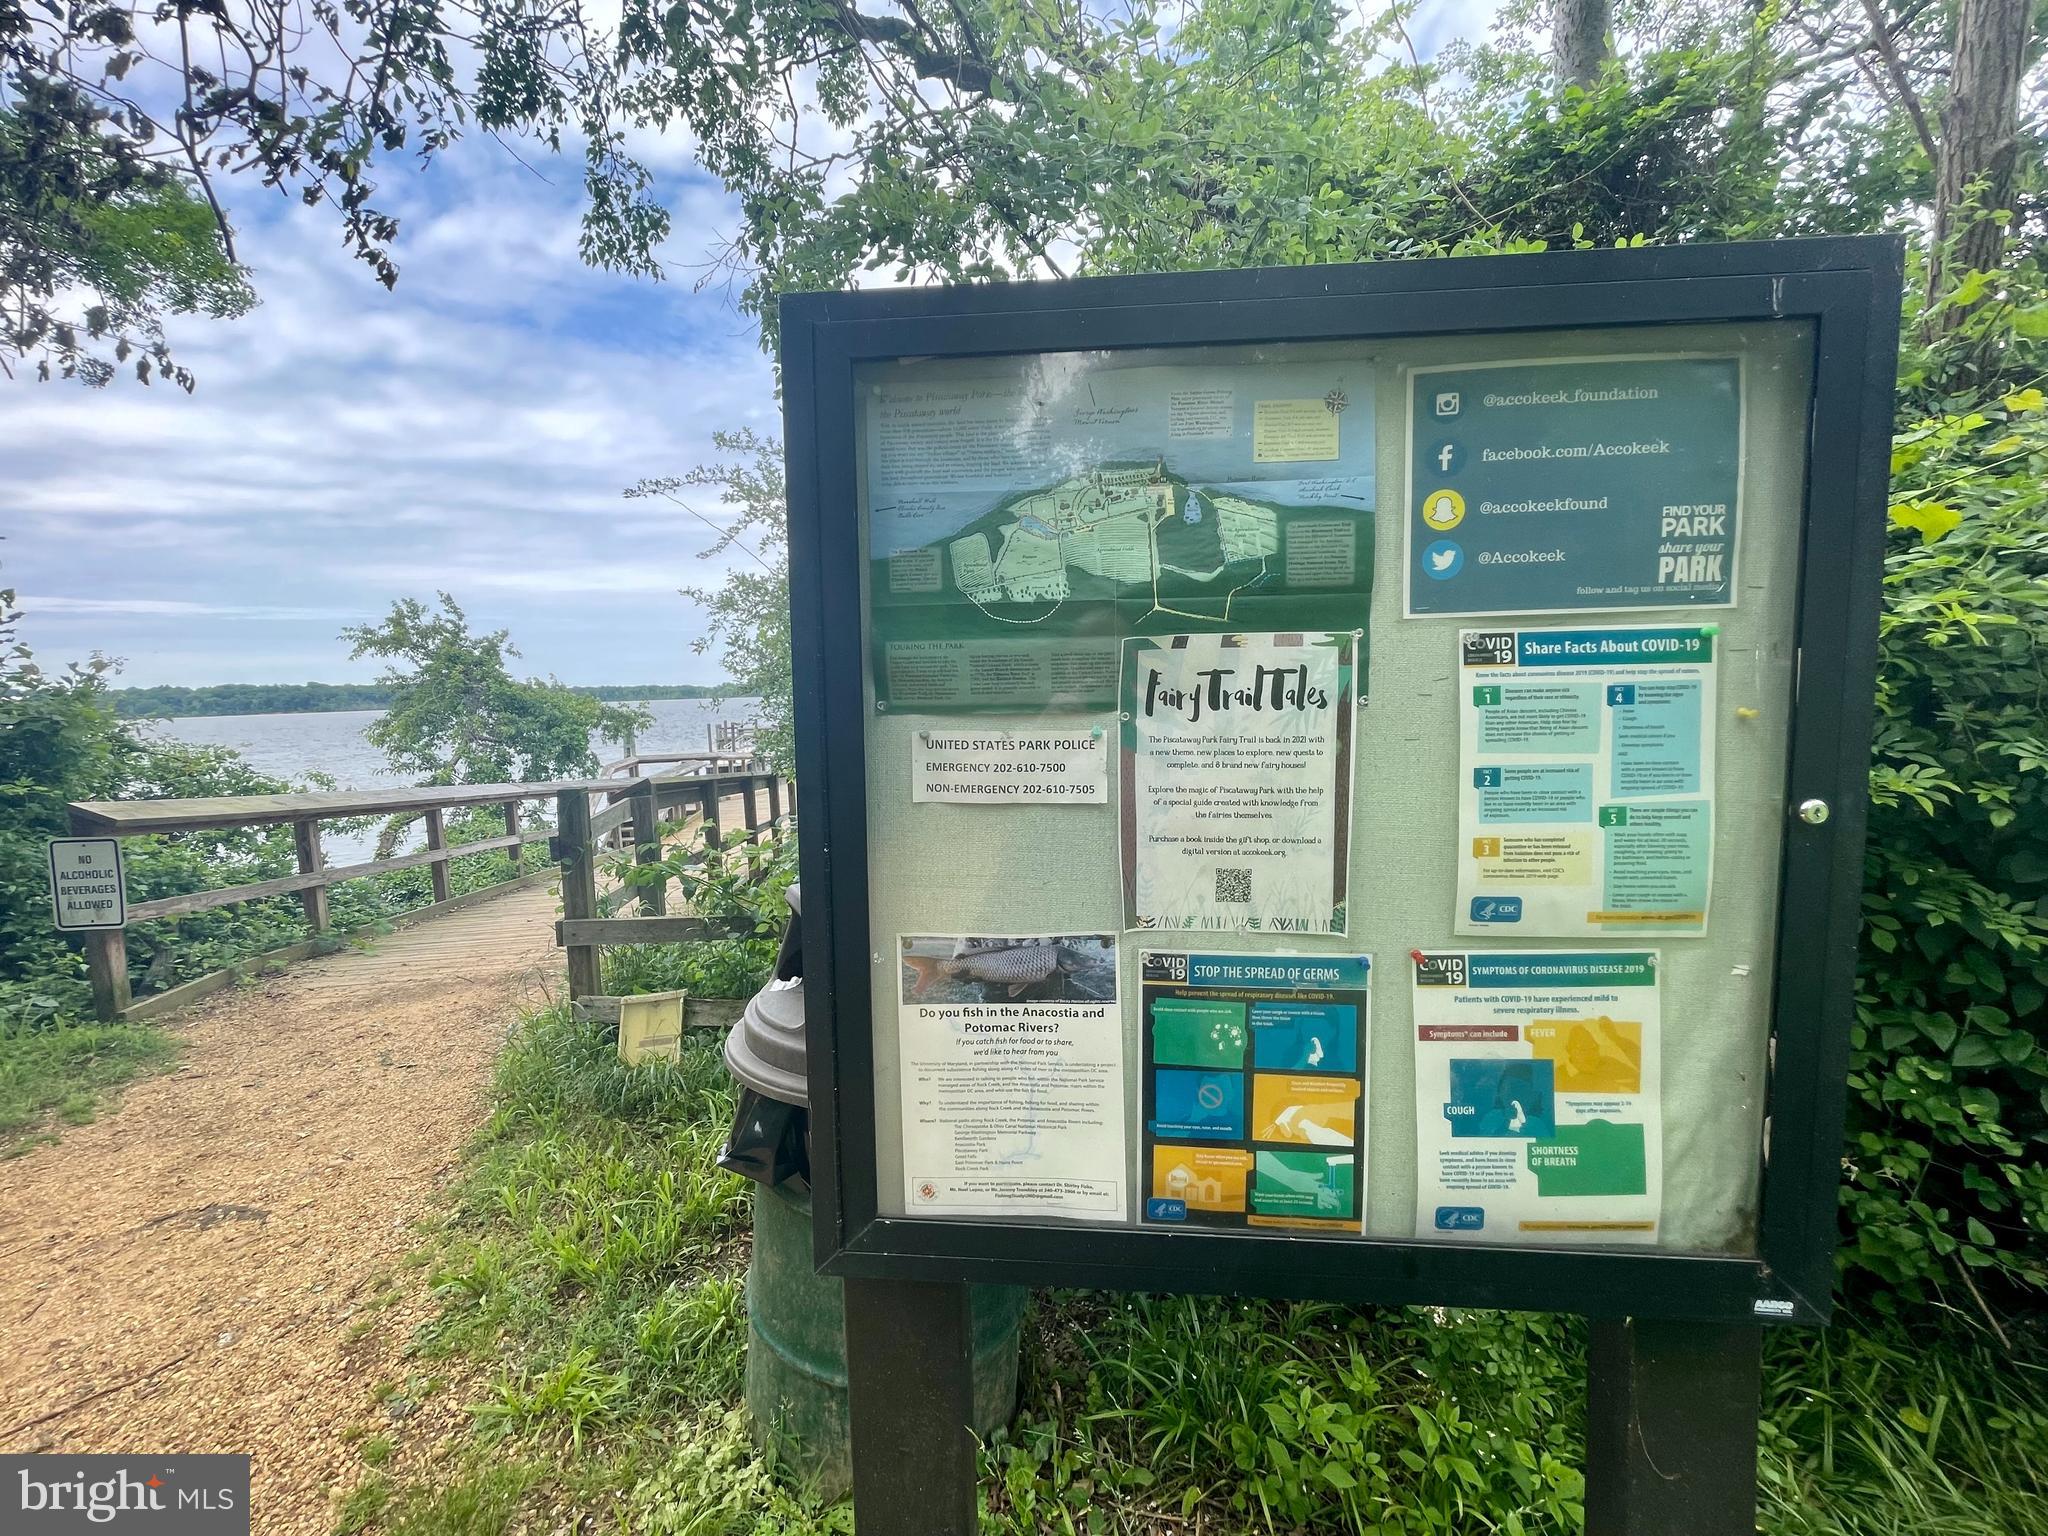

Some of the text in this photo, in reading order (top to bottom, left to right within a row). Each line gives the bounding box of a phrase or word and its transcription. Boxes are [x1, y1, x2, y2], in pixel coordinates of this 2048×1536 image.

[1483, 387, 1658, 406] @accokeek_foundation
[1482, 441, 1670, 462] facebook.com/Accokeek
[1480, 497, 1608, 514] @accokeekfound
[1663, 504, 1725, 517] FIND YOUR
[1661, 516, 1725, 537] PARK
[1658, 543, 1724, 555] share your
[1478, 550, 1565, 564] @Accokeek
[1658, 555, 1722, 583] PARK
[1576, 586, 1604, 594] follow
[1624, 586, 1639, 594] tag
[1525, 638, 1700, 654] Share Facts About COVID-19
[1494, 650, 1512, 663] 19
[1145, 669, 1200, 722] Fairy
[1197, 665, 1262, 711] Trail
[1262, 664, 1327, 711] Tales
[1616, 693, 1622, 703] 4
[1485, 694, 1491, 704] 1
[927, 740, 1095, 750] UNITED STATES PARK POLICE
[1163, 736, 1201, 745] Piscataway
[1220, 736, 1237, 745] Fairy
[926, 763, 1066, 772] EMERGENCY 202-610-7500
[1261, 761, 1280, 770] fairy
[1484, 776, 1490, 785] 2
[926, 784, 1094, 794] NON-EMERGENCY 202-610-7505
[1148, 786, 1174, 795] Explore
[1189, 786, 1208, 795] magic
[1220, 786, 1258, 795] Piscataway
[1309, 786, 1324, 795] help
[1169, 799, 1191, 808] special
[1194, 799, 1212, 808] guide
[1260, 799, 1298, 808] knowledge
[1611, 814, 1617, 824] 5
[1239, 836, 1252, 845] gift
[1182, 848, 1204, 857] digital
[1483, 845, 1489, 855] 3
[79, 856, 91, 864] NO
[60, 870, 113, 879] ALCOHOLIC
[61, 885, 116, 895] BEVERAGES
[67, 900, 113, 910] ALLOWED
[1500, 904, 1516, 912] CDC
[1420, 959, 1462, 970] COVID
[1170, 969, 1185, 979] 19
[1194, 965, 1339, 980] STOP THE SPREAD OF GERMS
[1473, 965, 1644, 975] SYMPTOMS OF CORONAVIRUS DISEASE 2019
[1446, 972, 1462, 984] 19
[1551, 995, 1592, 1004] experienced
[920, 1008, 1104, 1020] Do you fish in the Anacostia and
[1517, 1006, 1554, 1015] respiratory
[965, 1023, 1059, 1033] Potomac Rivers?
[1531, 1029, 1555, 1037] FEVER
[1483, 1030, 1507, 1038] include
[1447, 1106, 1474, 1115] COUGH
[1532, 1147, 1578, 1155] SHORTNESS
[1532, 1157, 1576, 1166] OF BREATH
